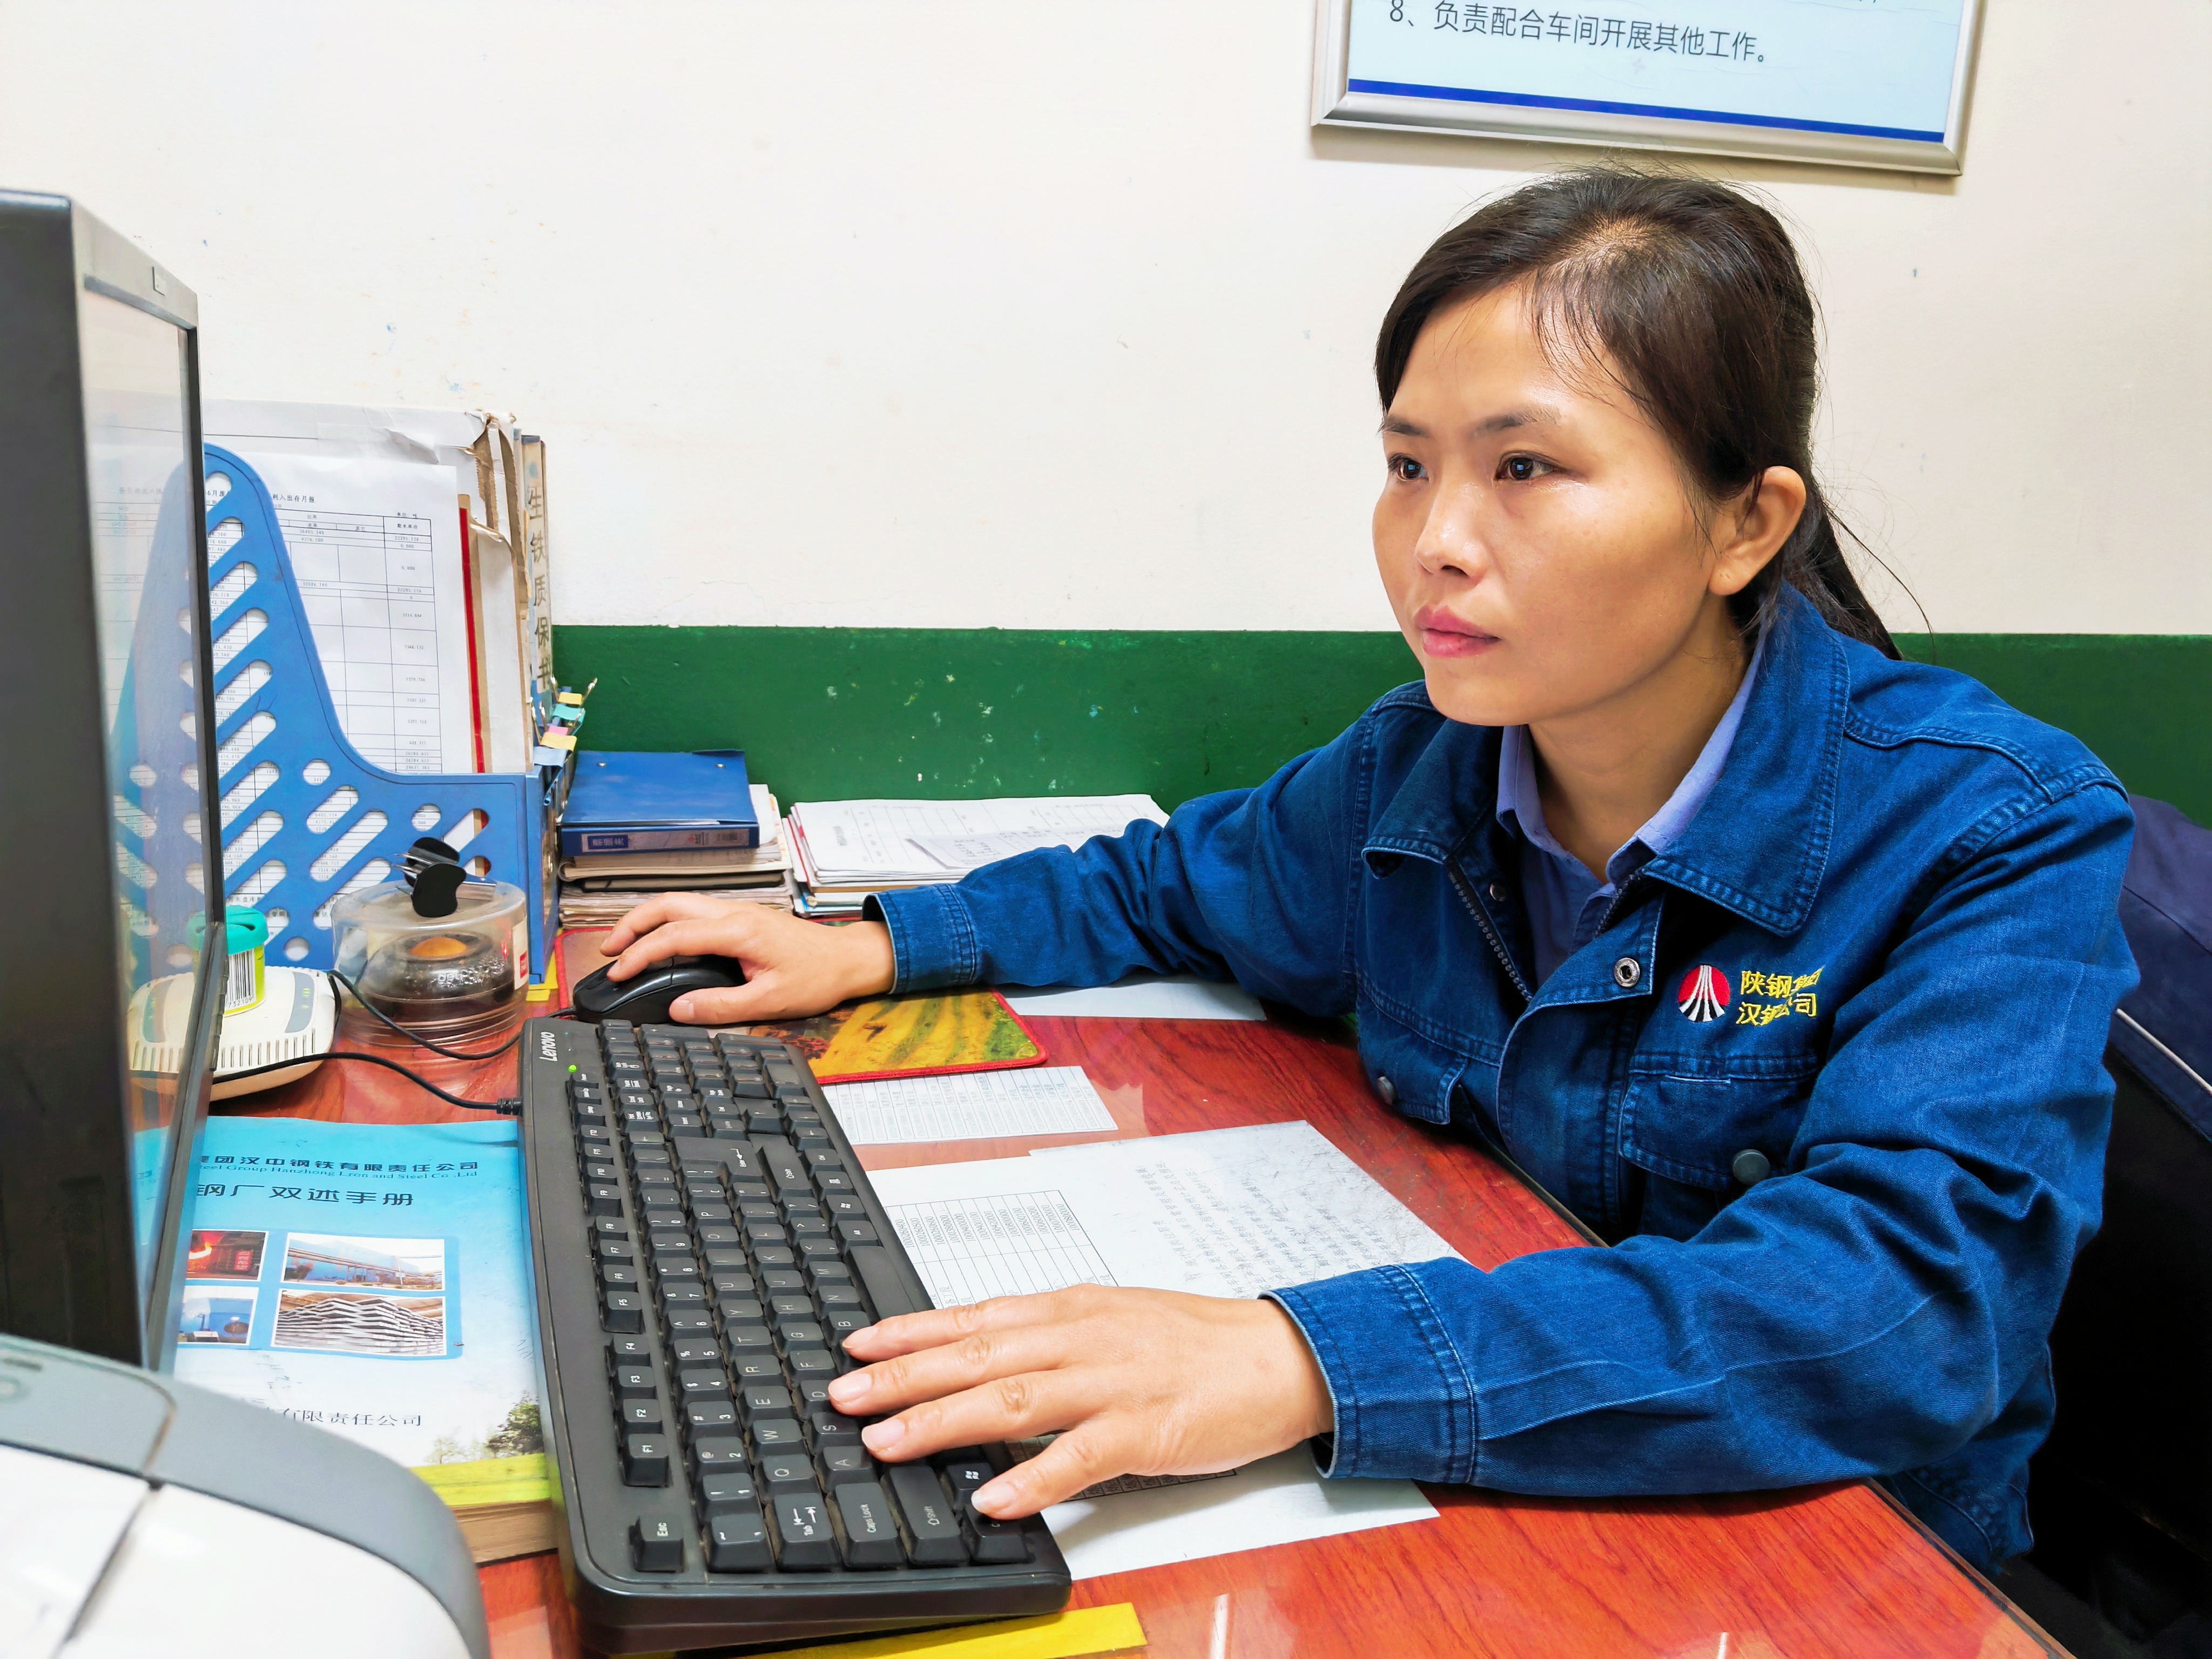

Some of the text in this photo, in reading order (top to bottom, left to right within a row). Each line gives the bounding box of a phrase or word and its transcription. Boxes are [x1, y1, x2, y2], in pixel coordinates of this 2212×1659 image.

[1389, 0, 1764, 62] 8、负责配合车间开展其他工作。
[228, 996, 252, 1008] 732109
[539, 1031, 557, 1061] Lenovo
[631, 1375, 640, 1383] F3
[636, 1409, 646, 1417] F2
[763, 1430, 778, 1440] W
[642, 1445, 653, 1453] F1
[774, 1468, 790, 1477] Q
[860, 1503, 877, 1533] Caps Lock
[924, 1506, 936, 1518] Shift
[657, 1522, 668, 1536] Esc
